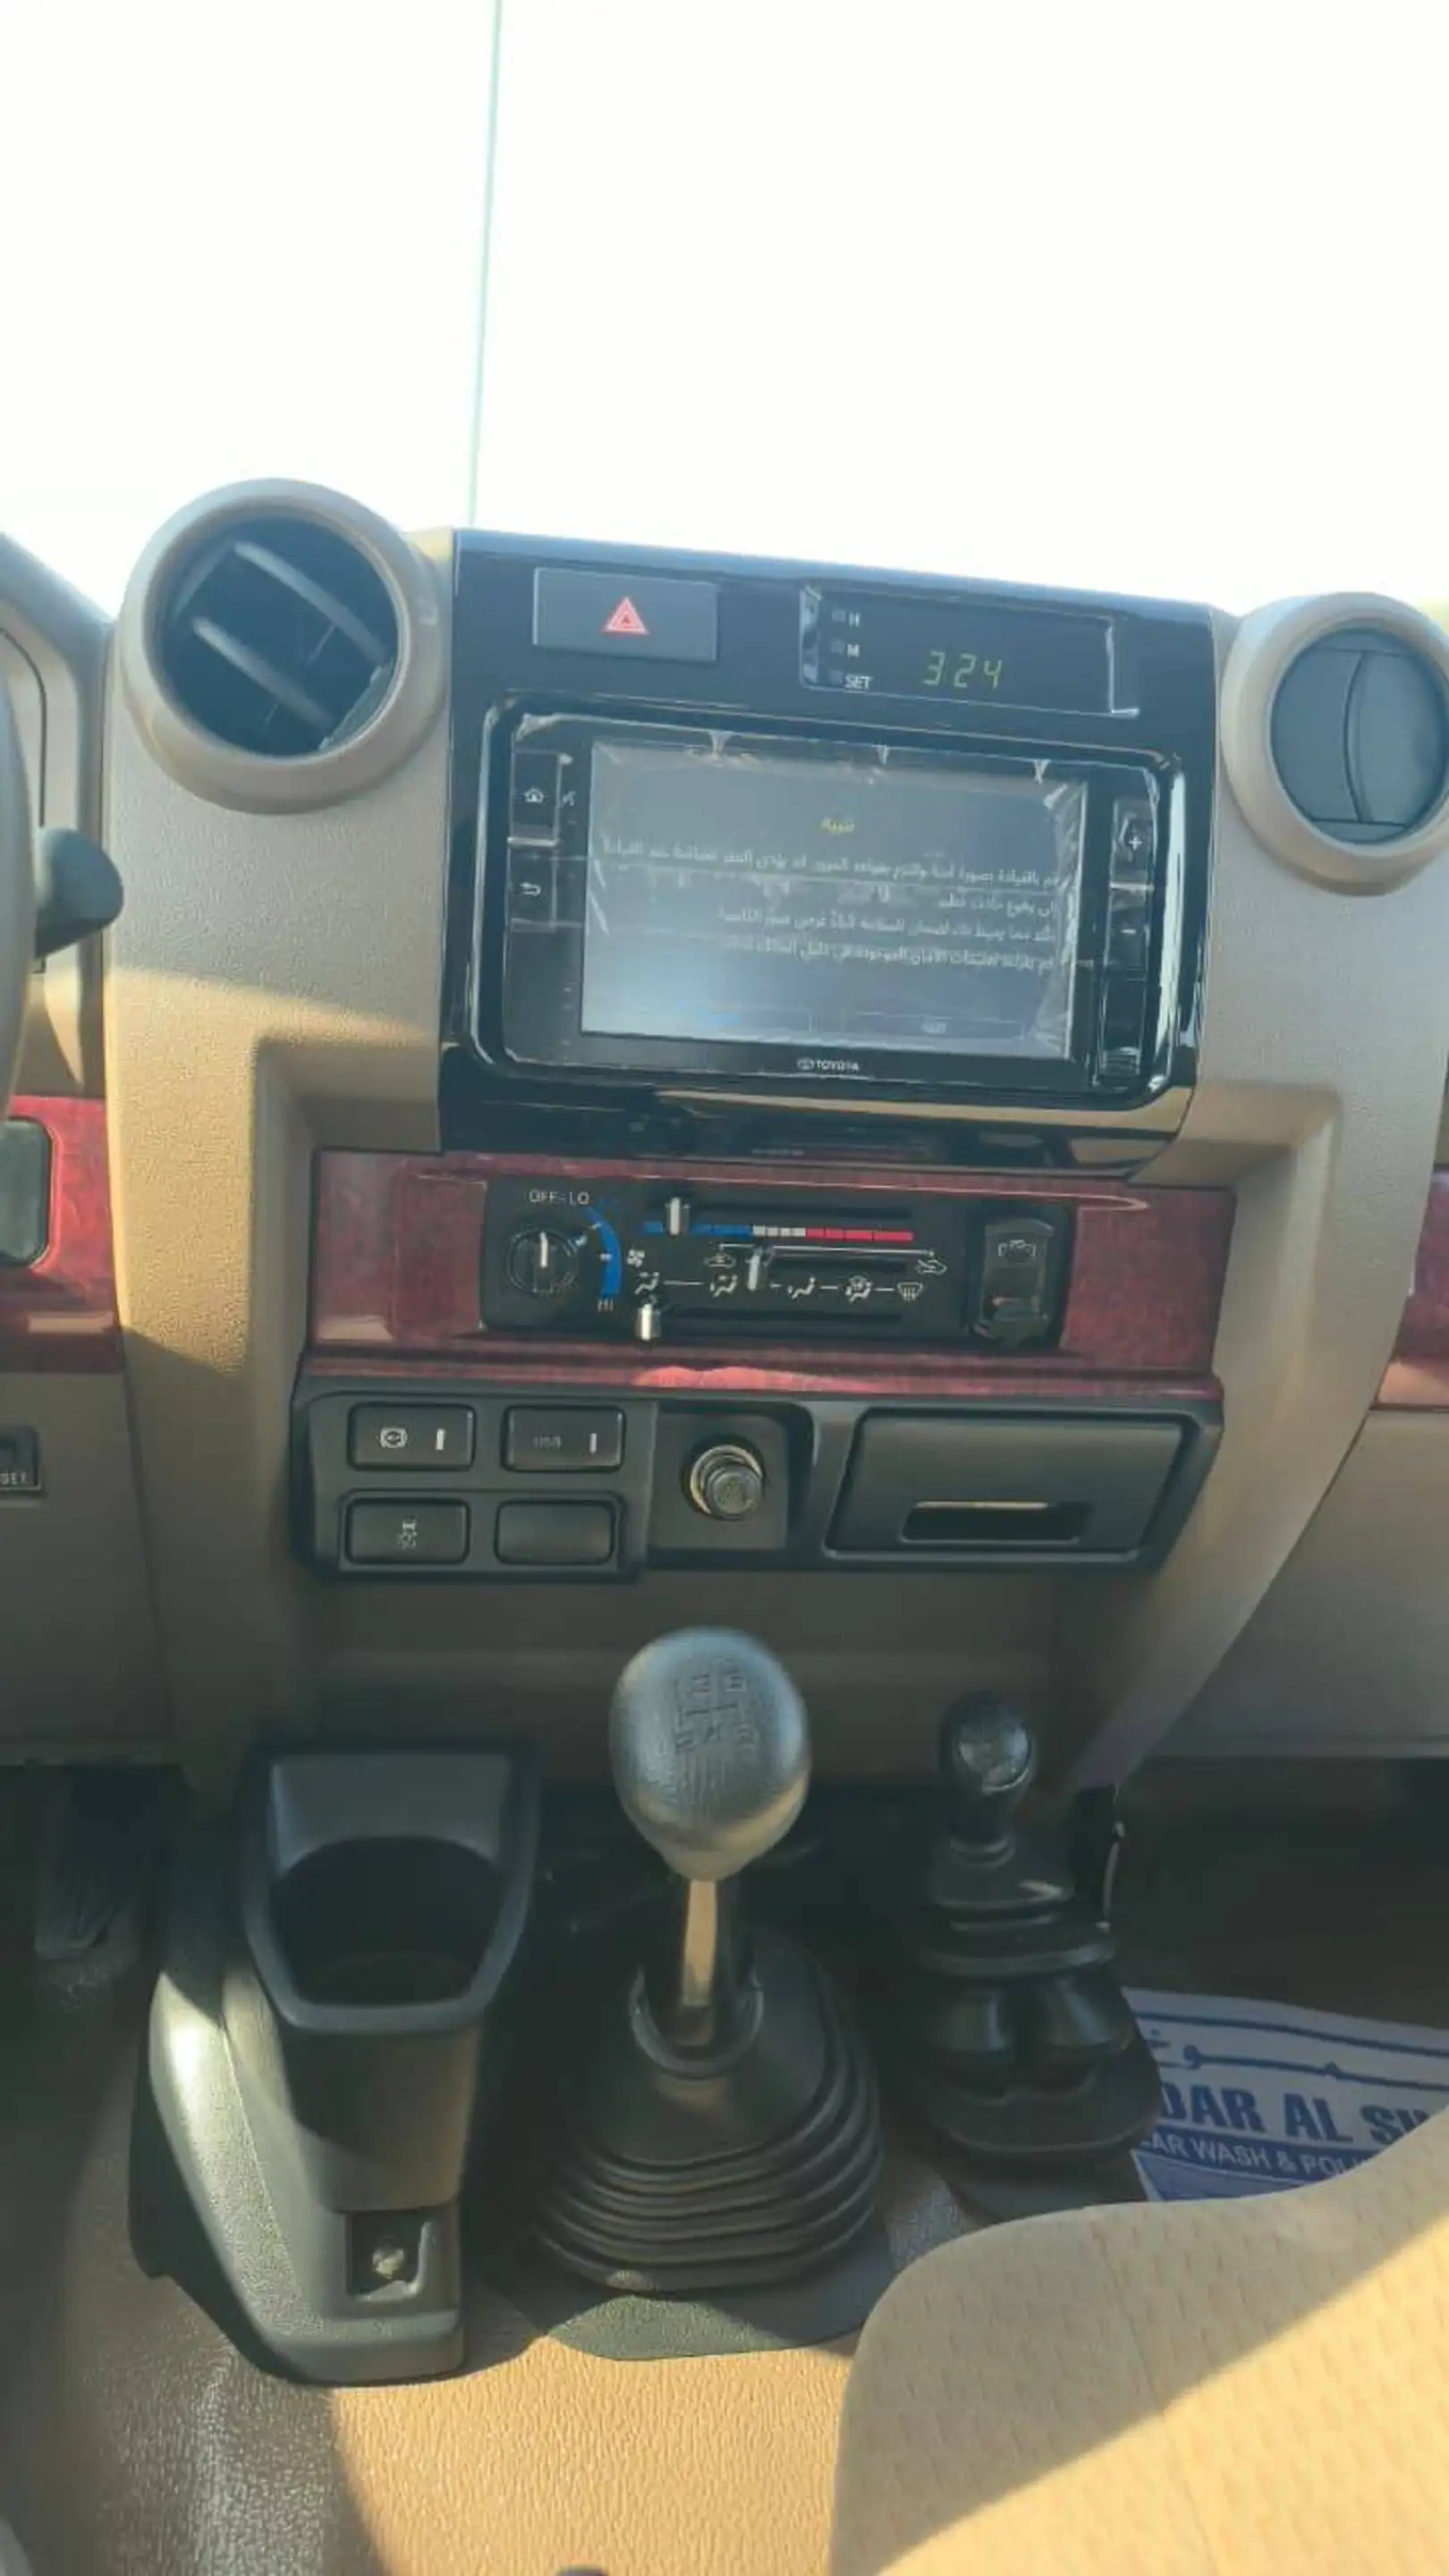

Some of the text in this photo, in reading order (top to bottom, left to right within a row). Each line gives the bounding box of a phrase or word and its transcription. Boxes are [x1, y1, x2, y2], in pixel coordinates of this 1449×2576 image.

[848, 644, 860, 657] M
[845, 674, 873, 689] SET
[816, 1058, 860, 1073] TOYOTA
[1284, 2092, 1354, 2143] AL
[1189, 2136, 1273, 2171] WASH
